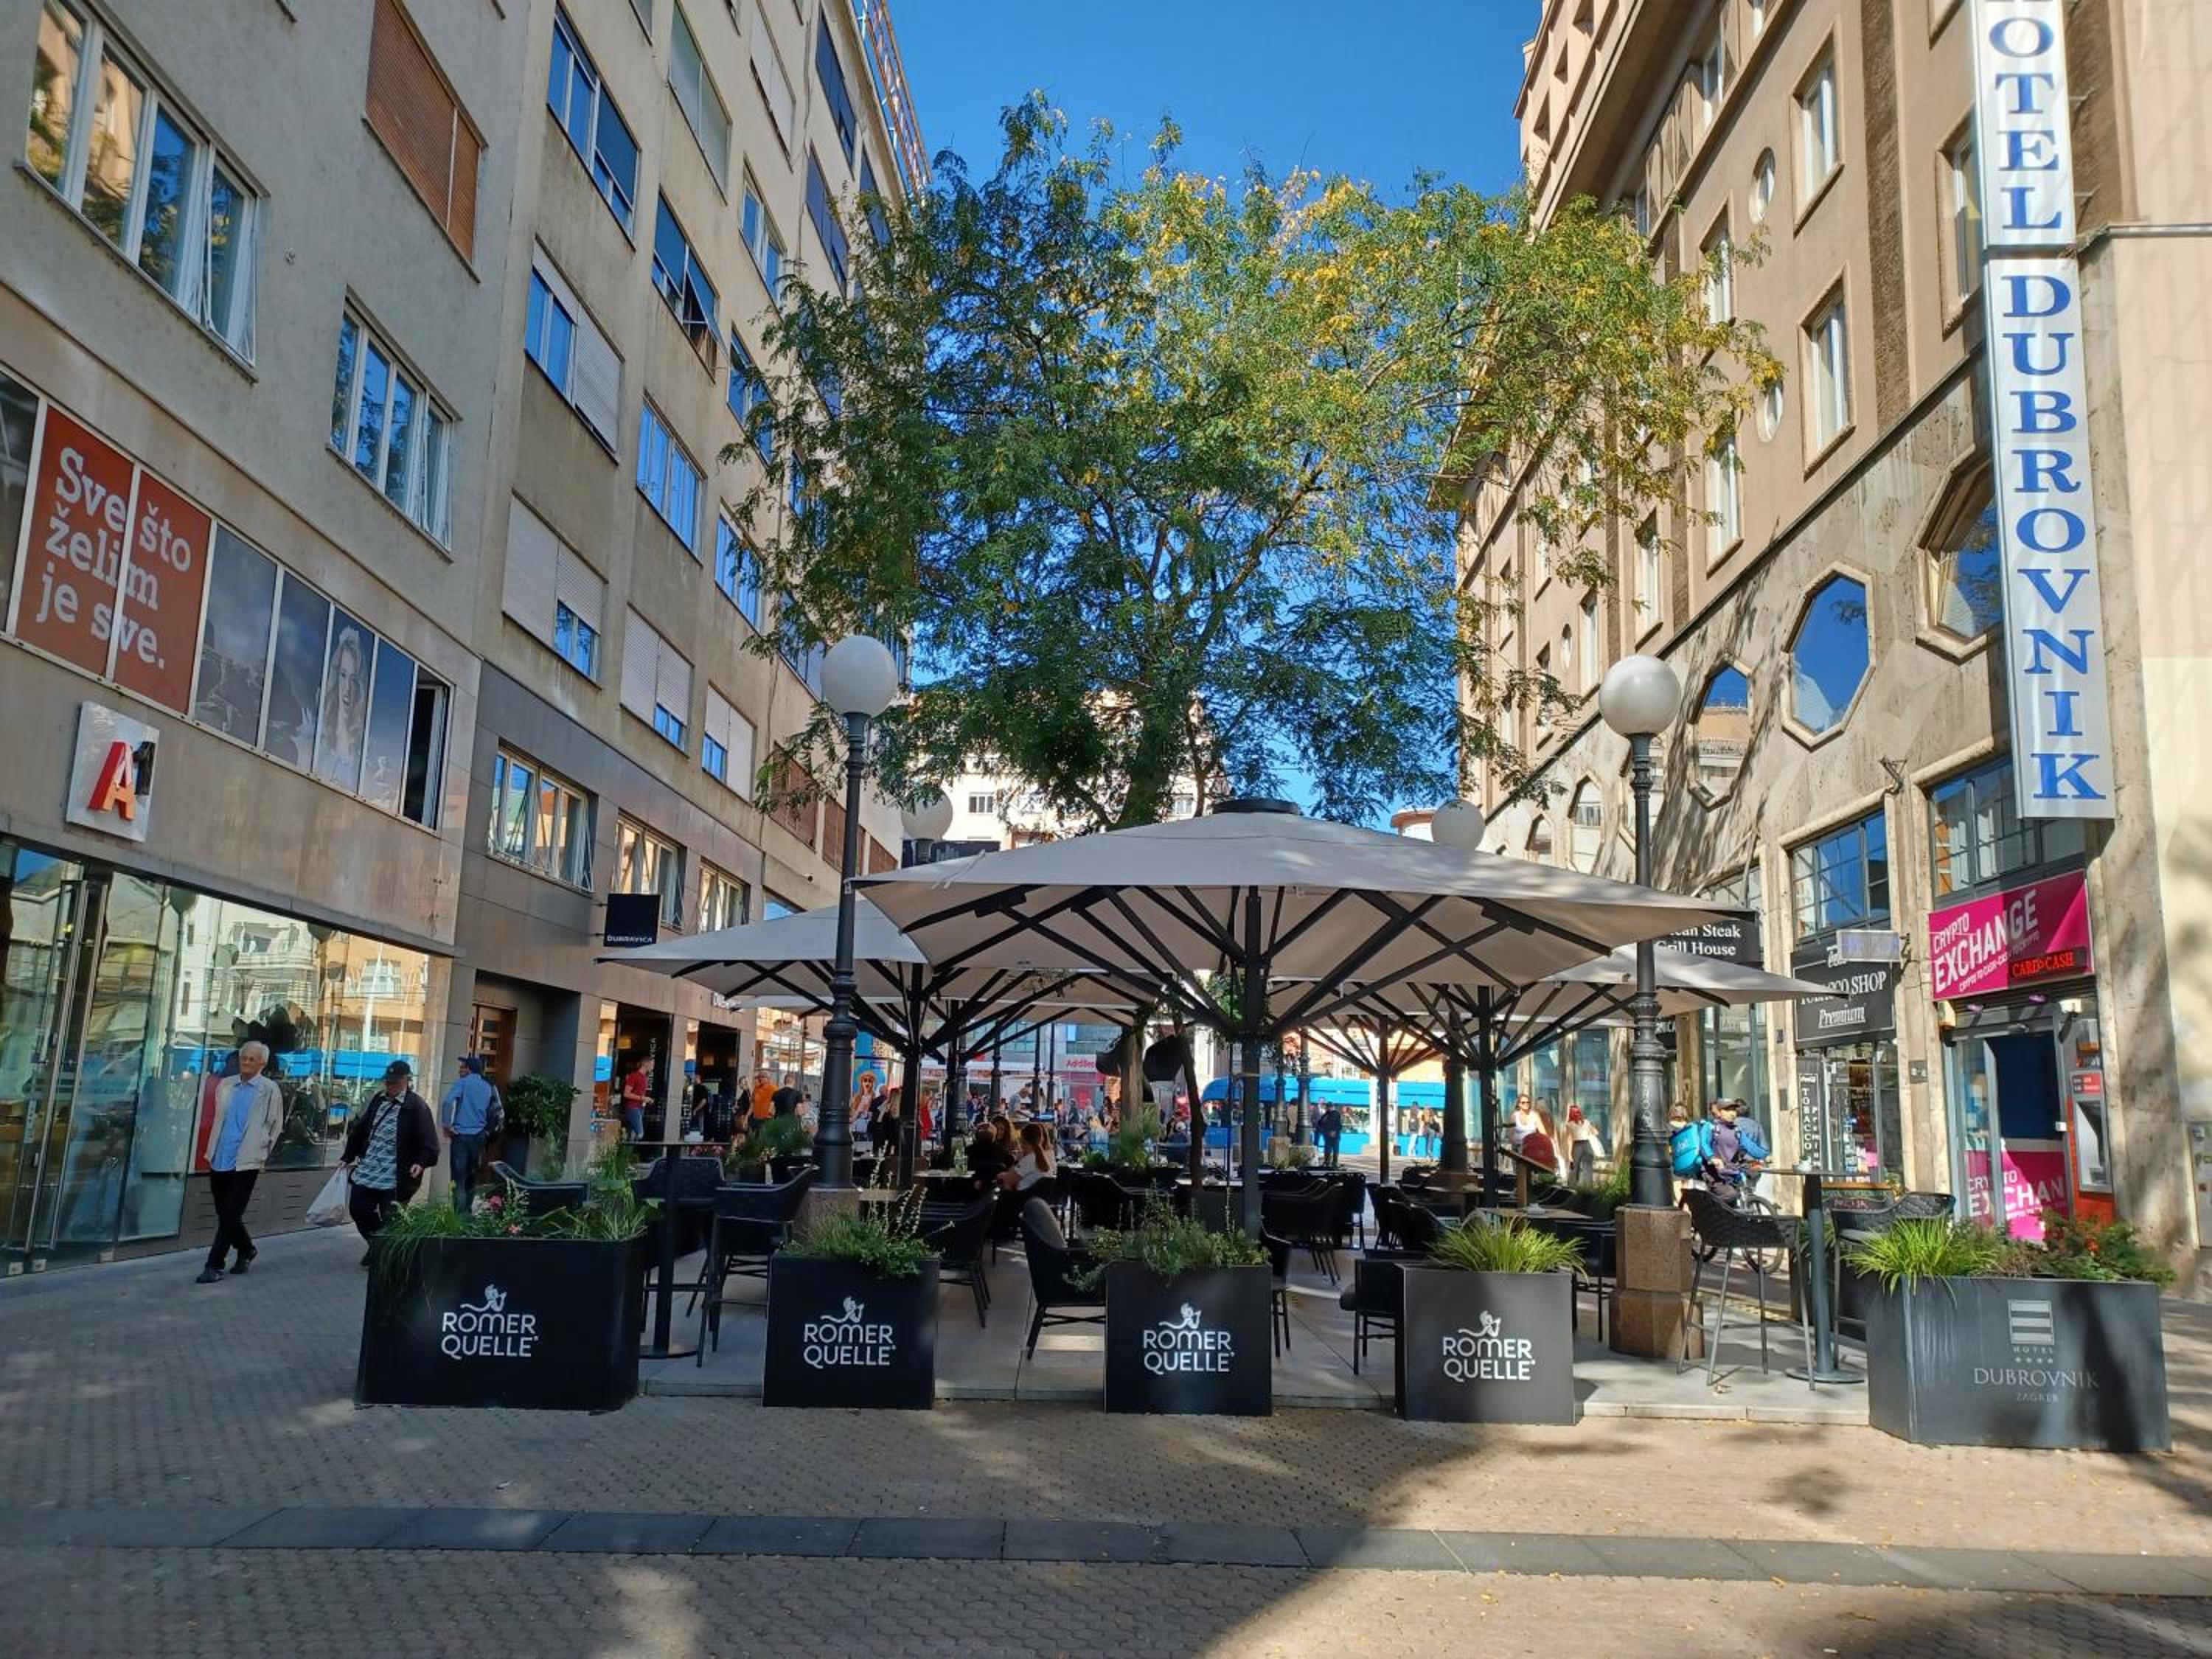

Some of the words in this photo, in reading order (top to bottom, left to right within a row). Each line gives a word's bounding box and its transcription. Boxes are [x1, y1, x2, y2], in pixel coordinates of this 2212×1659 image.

[1989, 0, 2062, 230] OTEL
[55, 447, 127, 533] Sve
[139, 501, 191, 572] što
[2001, 274, 2107, 800] DUBROVNIK
[46, 501, 159, 611] želim
[35, 561, 78, 624] je
[91, 602, 165, 669] sve.
[88, 740, 156, 821] A1
[1691, 942, 1736, 956] House
[1703, 924, 1742, 938] Steak
[1933, 912, 1970, 954] CRYPTO
[1934, 889, 2039, 993] EXCHANGE
[1851, 971, 1887, 995] SHOP
[1818, 1004, 1866, 1029] Premium
[1801, 1088, 1812, 1150] TOBACCO
[1973, 1368, 2100, 1388] DUBROVNIK
[2013, 1346, 2054, 1354] HOTEL
